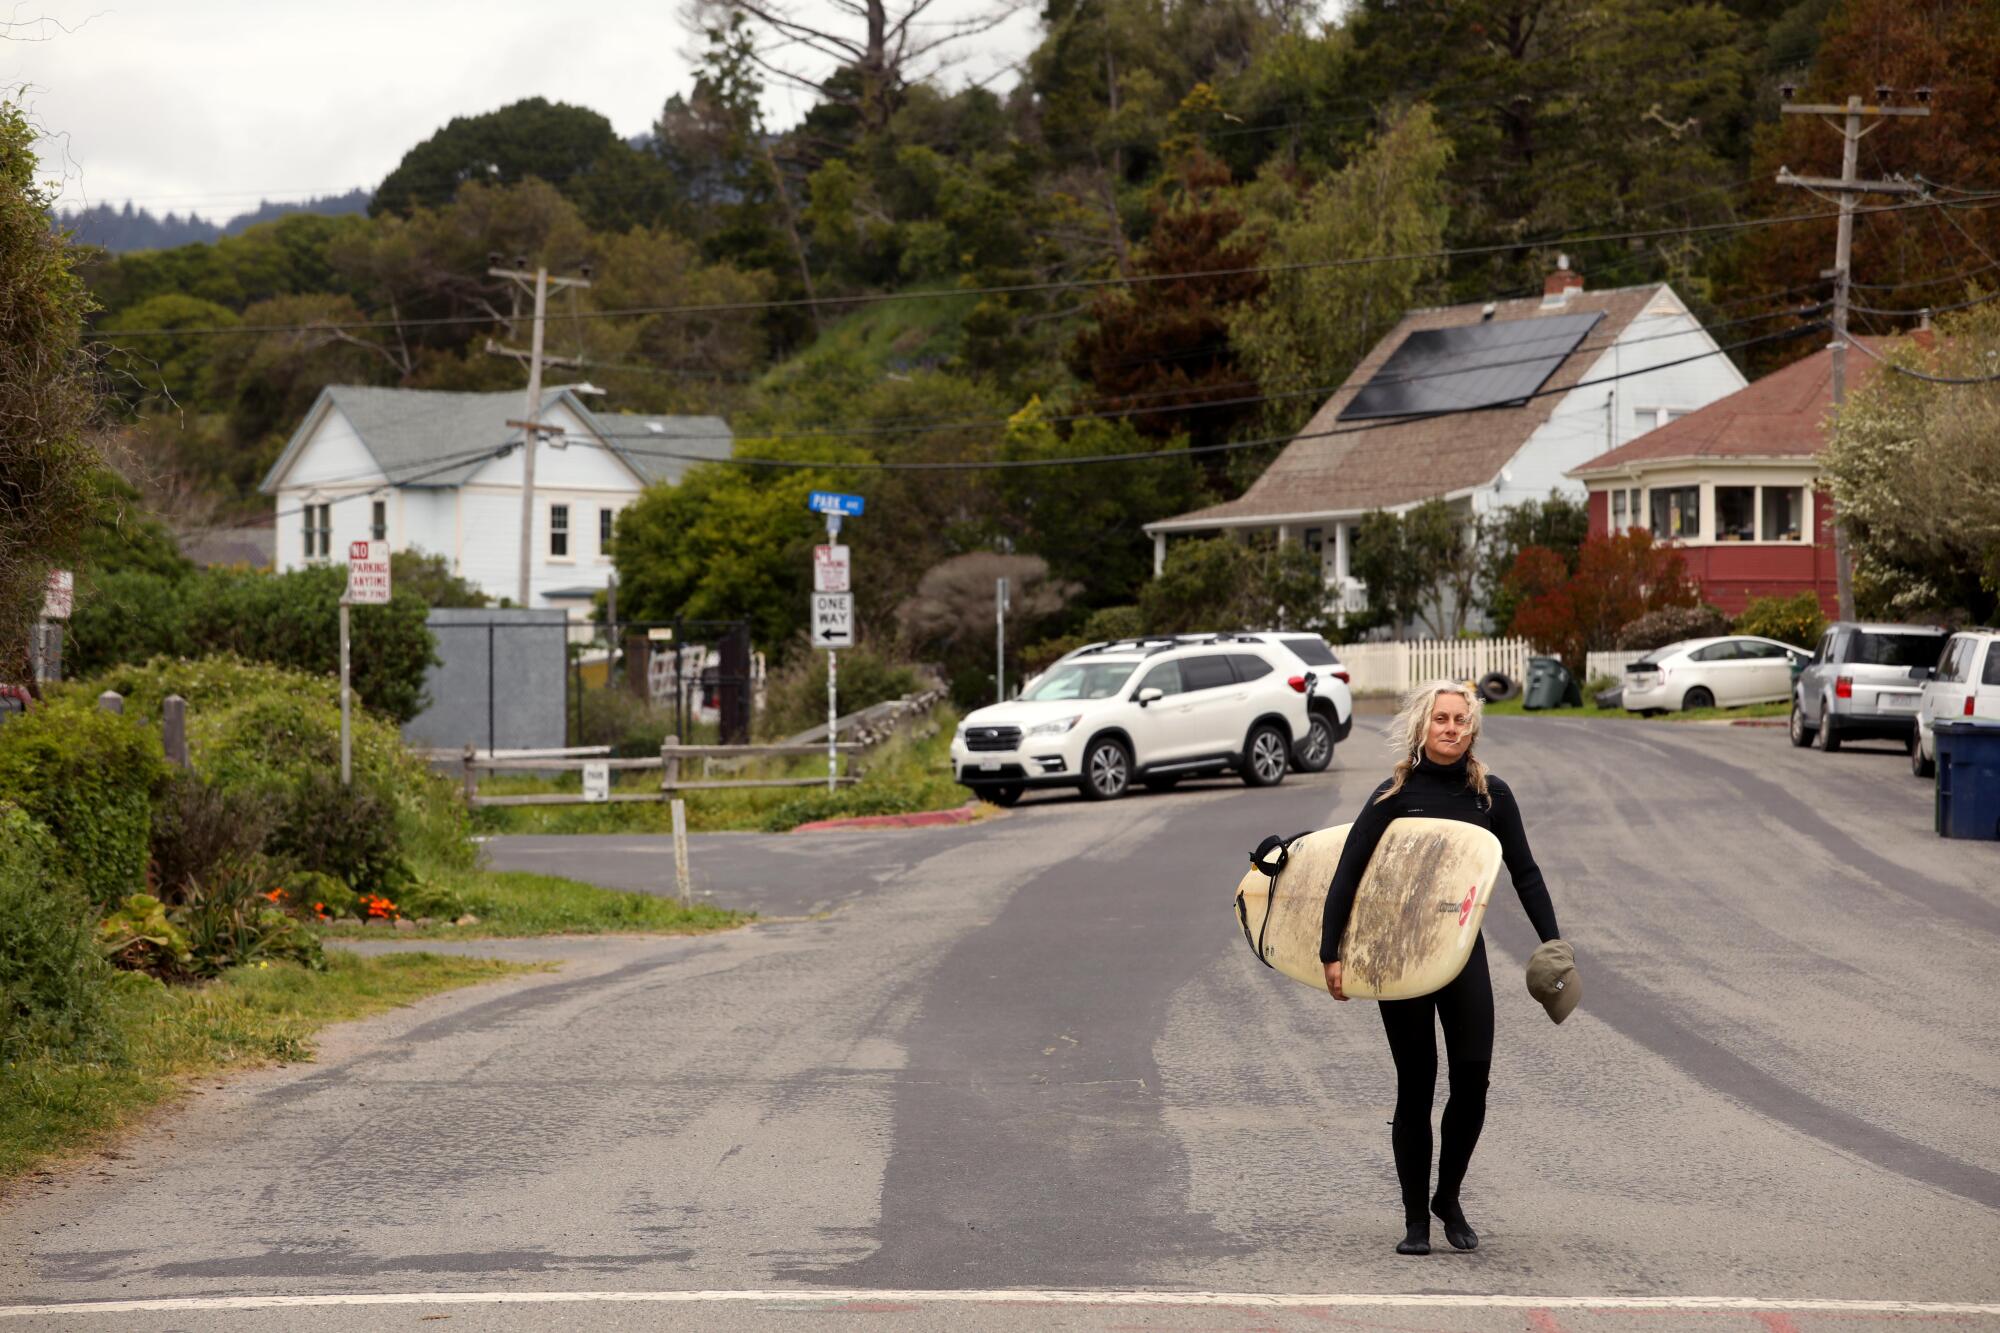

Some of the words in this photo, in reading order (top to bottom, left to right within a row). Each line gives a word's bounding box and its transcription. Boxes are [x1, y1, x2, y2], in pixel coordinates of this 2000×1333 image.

[352, 543, 368, 558] NO
[351, 562, 388, 574] PARKING
[353, 576, 387, 588] ANYTIME
[817, 597, 847, 611] ONE
[818, 612, 848, 626] WAY
